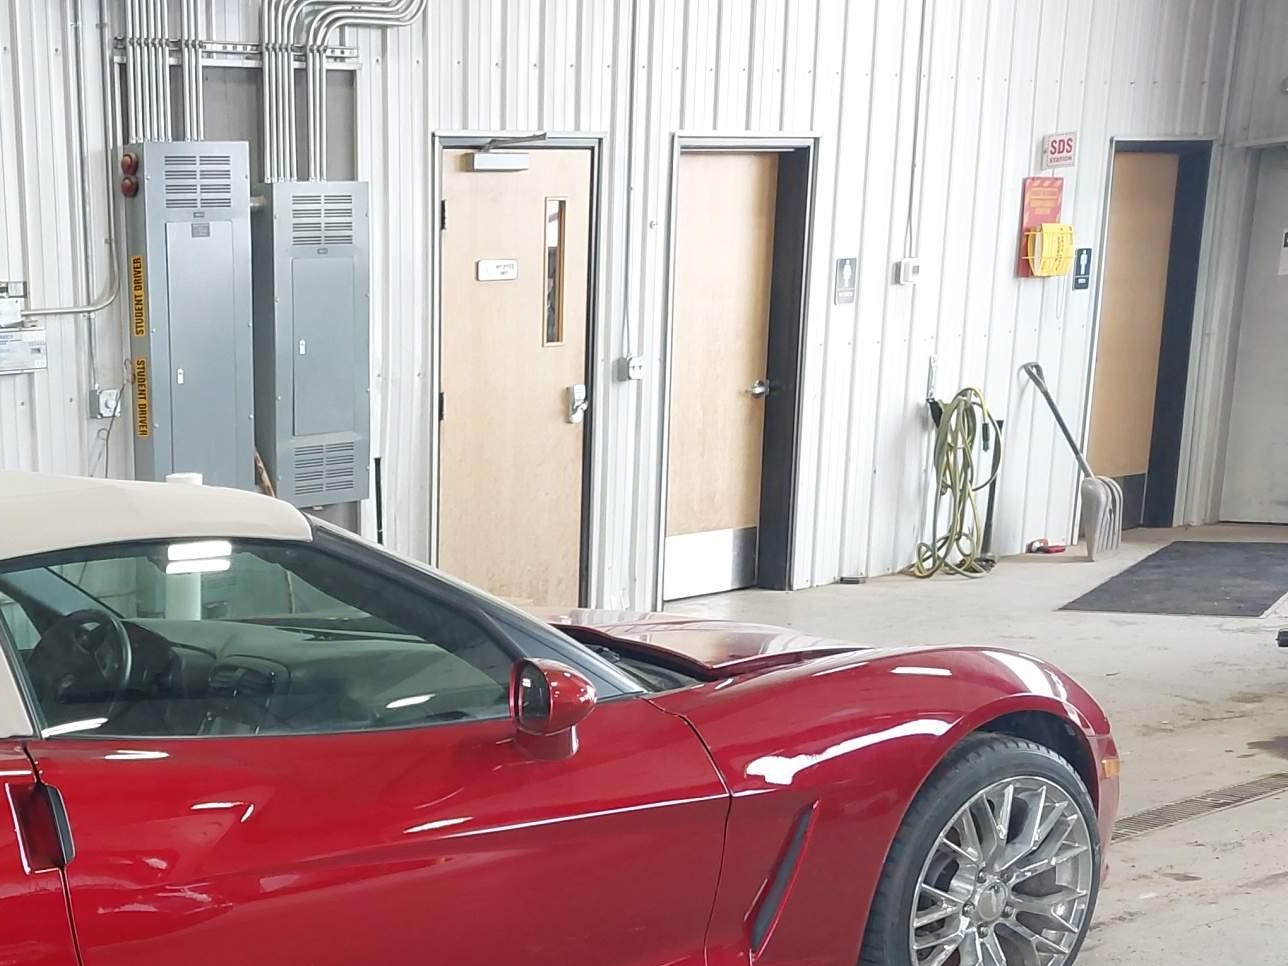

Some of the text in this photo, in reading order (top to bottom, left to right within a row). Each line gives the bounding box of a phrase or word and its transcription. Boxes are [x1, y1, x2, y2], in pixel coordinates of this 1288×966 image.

[1050, 138, 1073, 155] SDS
[132, 257, 144, 336] STUDENT DRIVER
[136, 360, 148, 436] STUDENT DRIVER
